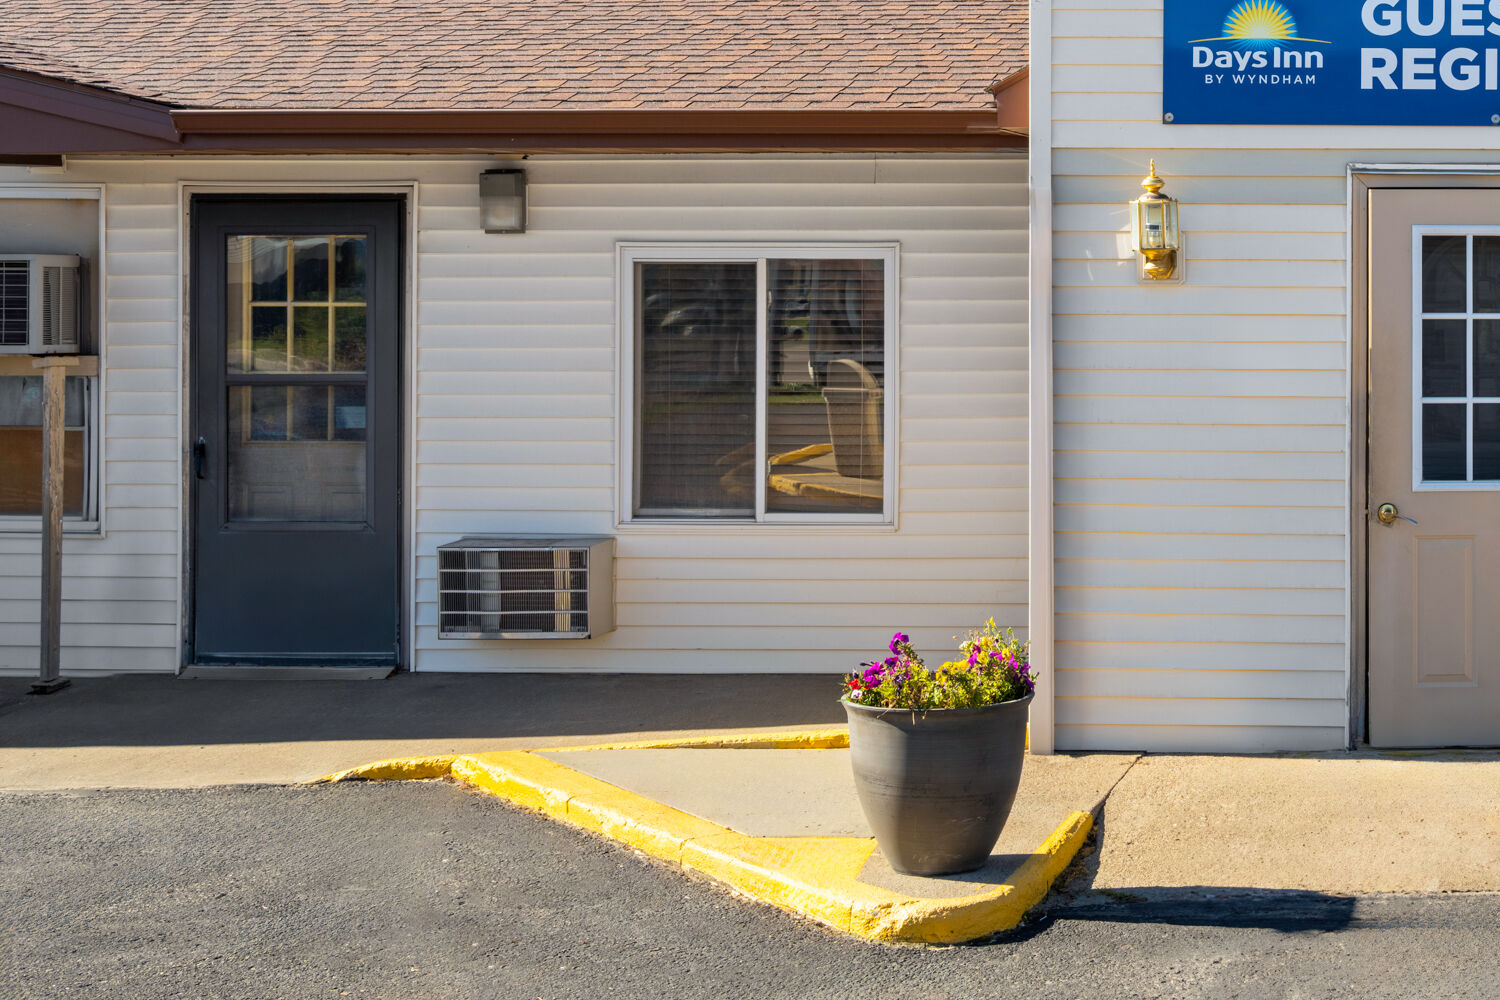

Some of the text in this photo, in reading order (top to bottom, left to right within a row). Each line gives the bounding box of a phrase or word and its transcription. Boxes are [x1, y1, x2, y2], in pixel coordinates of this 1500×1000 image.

[1192, 46, 1324, 72] Days Inn
[1205, 74, 1316, 85] BY WYNDHAM
